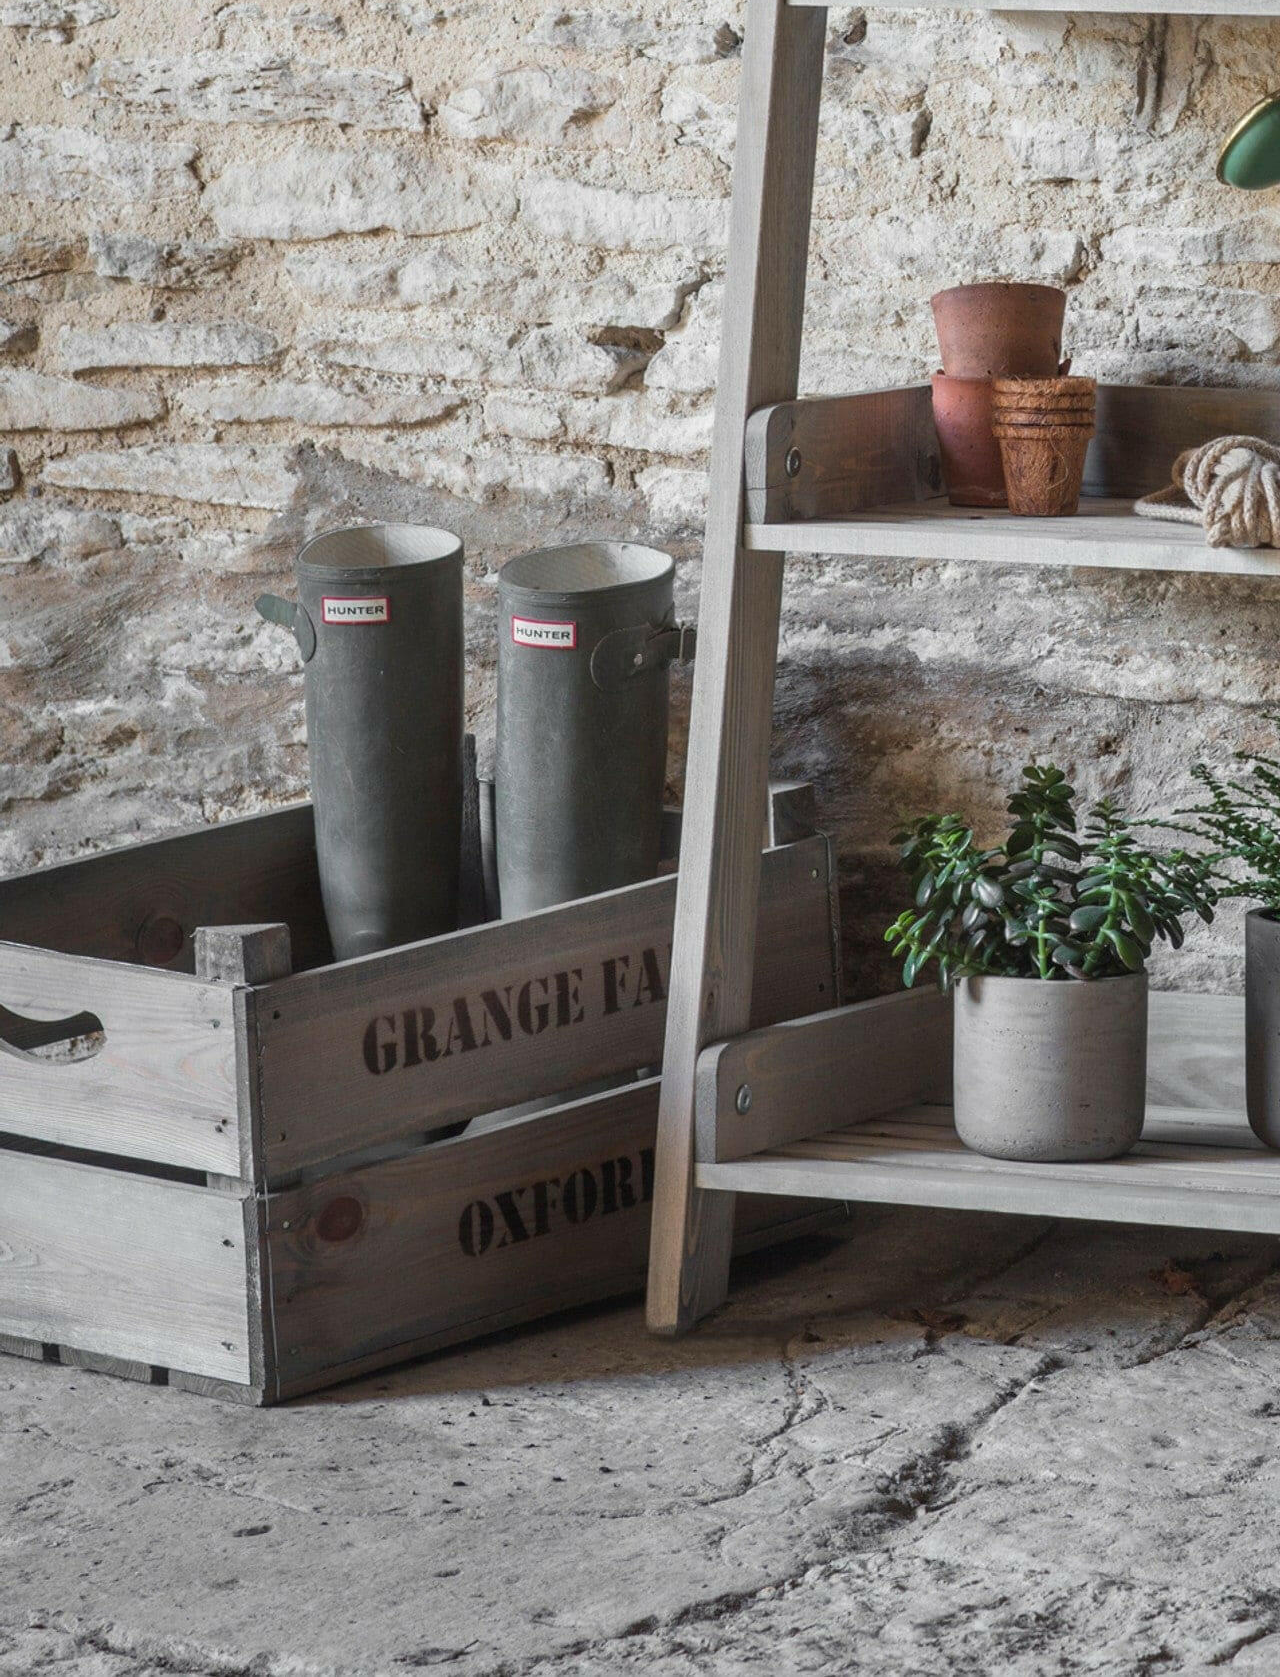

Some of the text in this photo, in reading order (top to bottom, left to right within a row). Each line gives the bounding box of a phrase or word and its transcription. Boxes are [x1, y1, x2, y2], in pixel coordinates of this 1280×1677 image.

[327, 604, 385, 616] HUNTER
[515, 627, 571, 641] HUNTER
[362, 944, 673, 1075] GRANGE FA
